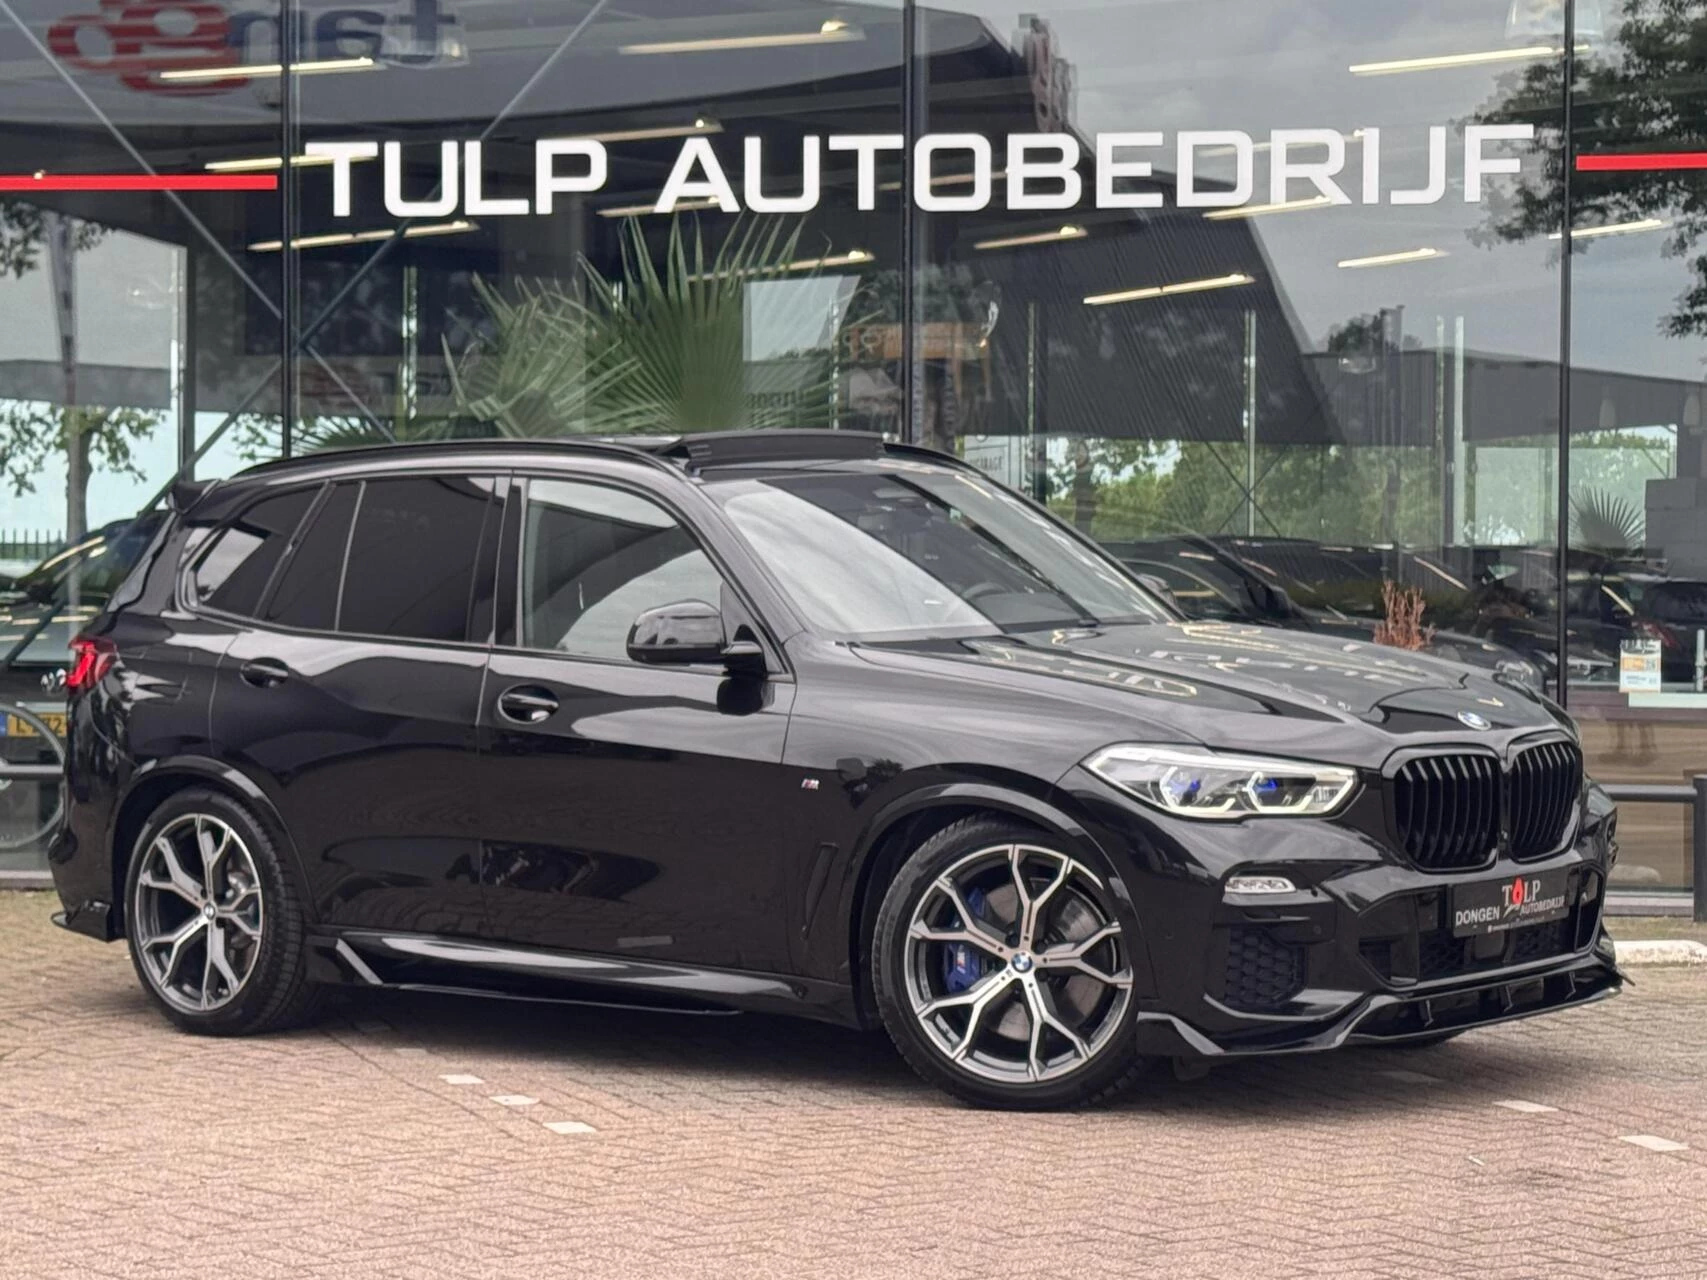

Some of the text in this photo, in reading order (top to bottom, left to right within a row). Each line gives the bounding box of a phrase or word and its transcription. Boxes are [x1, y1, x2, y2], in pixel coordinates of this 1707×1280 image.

[304, 124, 1535, 218] TULP AUTOBEDRIJF
[1455, 906, 1500, 927] DONGEN
